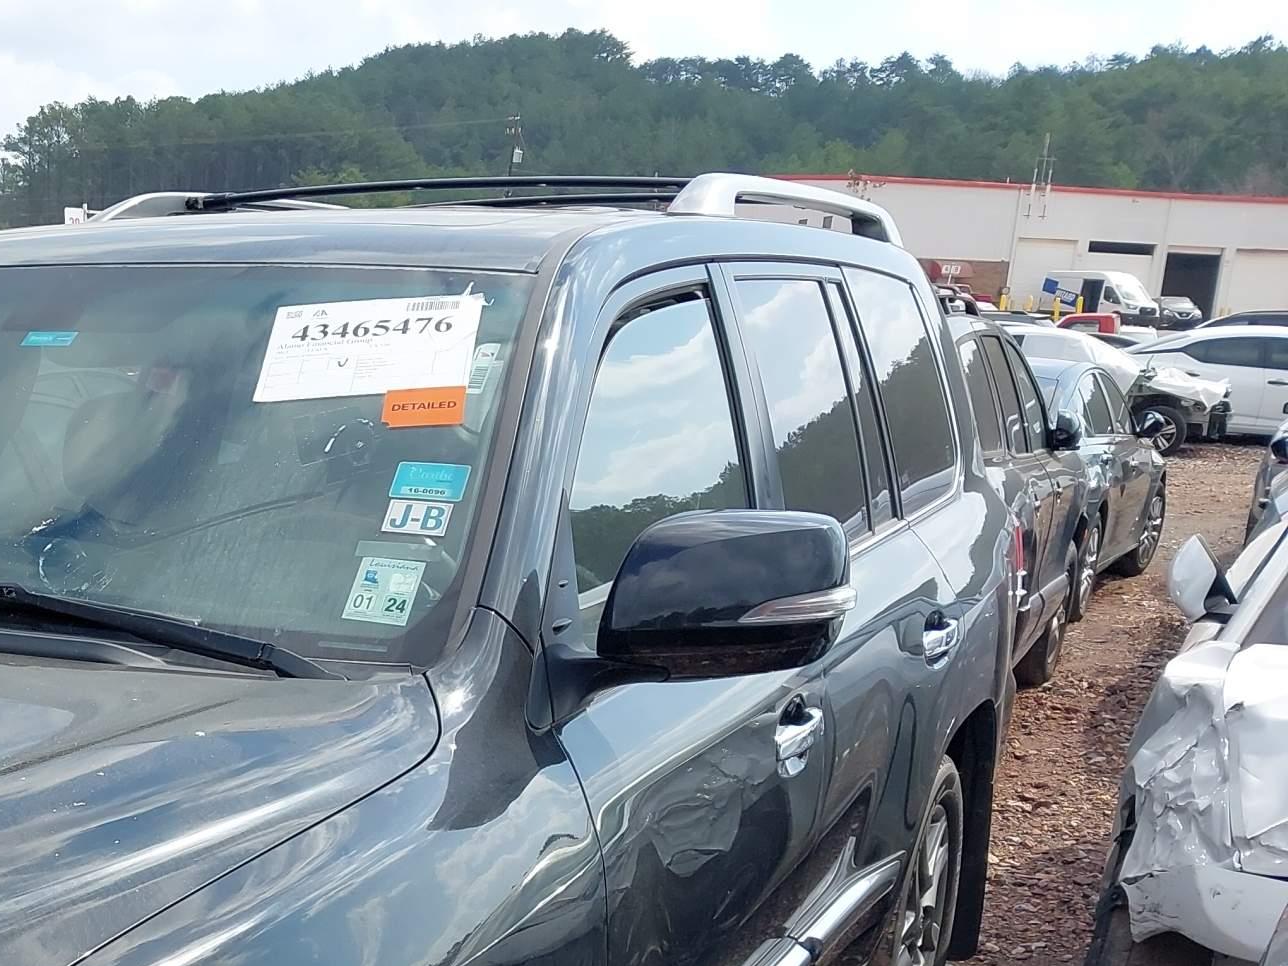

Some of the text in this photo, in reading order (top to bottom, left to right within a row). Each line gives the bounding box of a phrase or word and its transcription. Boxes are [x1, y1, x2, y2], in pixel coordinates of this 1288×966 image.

[292, 315, 453, 342] 43465476
[391, 400, 457, 412] DETAILED
[389, 504, 447, 531] J-B
[352, 594, 408, 613] 01 24
